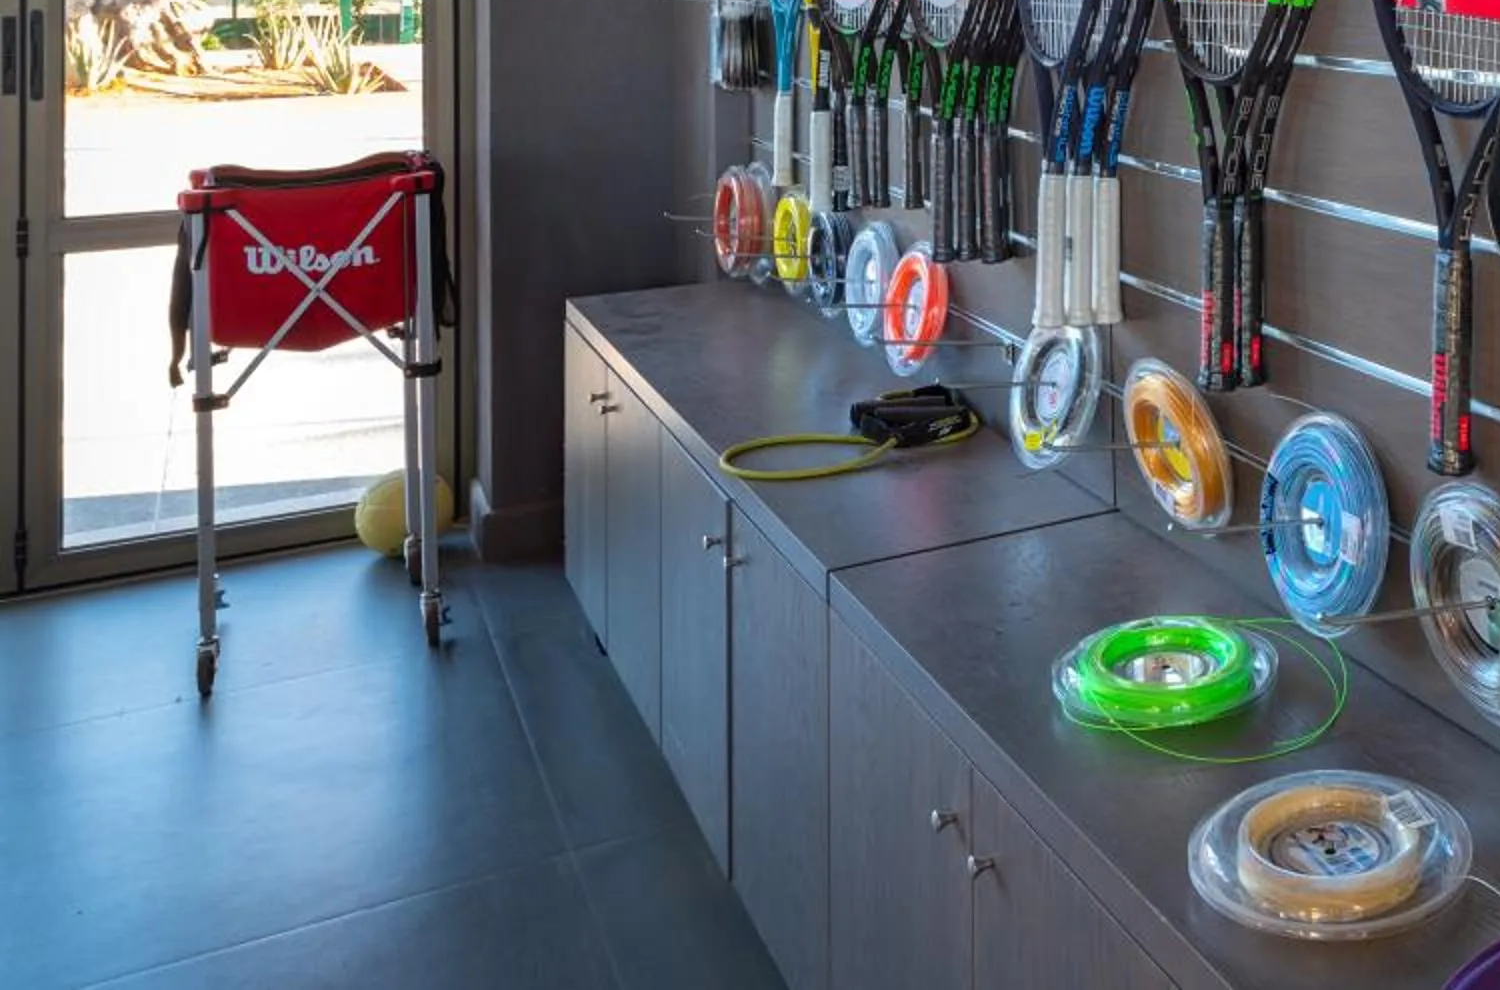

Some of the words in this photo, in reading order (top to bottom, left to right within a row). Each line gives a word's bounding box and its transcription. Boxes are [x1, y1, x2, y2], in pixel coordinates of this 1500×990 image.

[1223, 96, 1254, 194] BLADE
[1250, 94, 1280, 191] BLADE
[244, 244, 382, 275] Wilson
